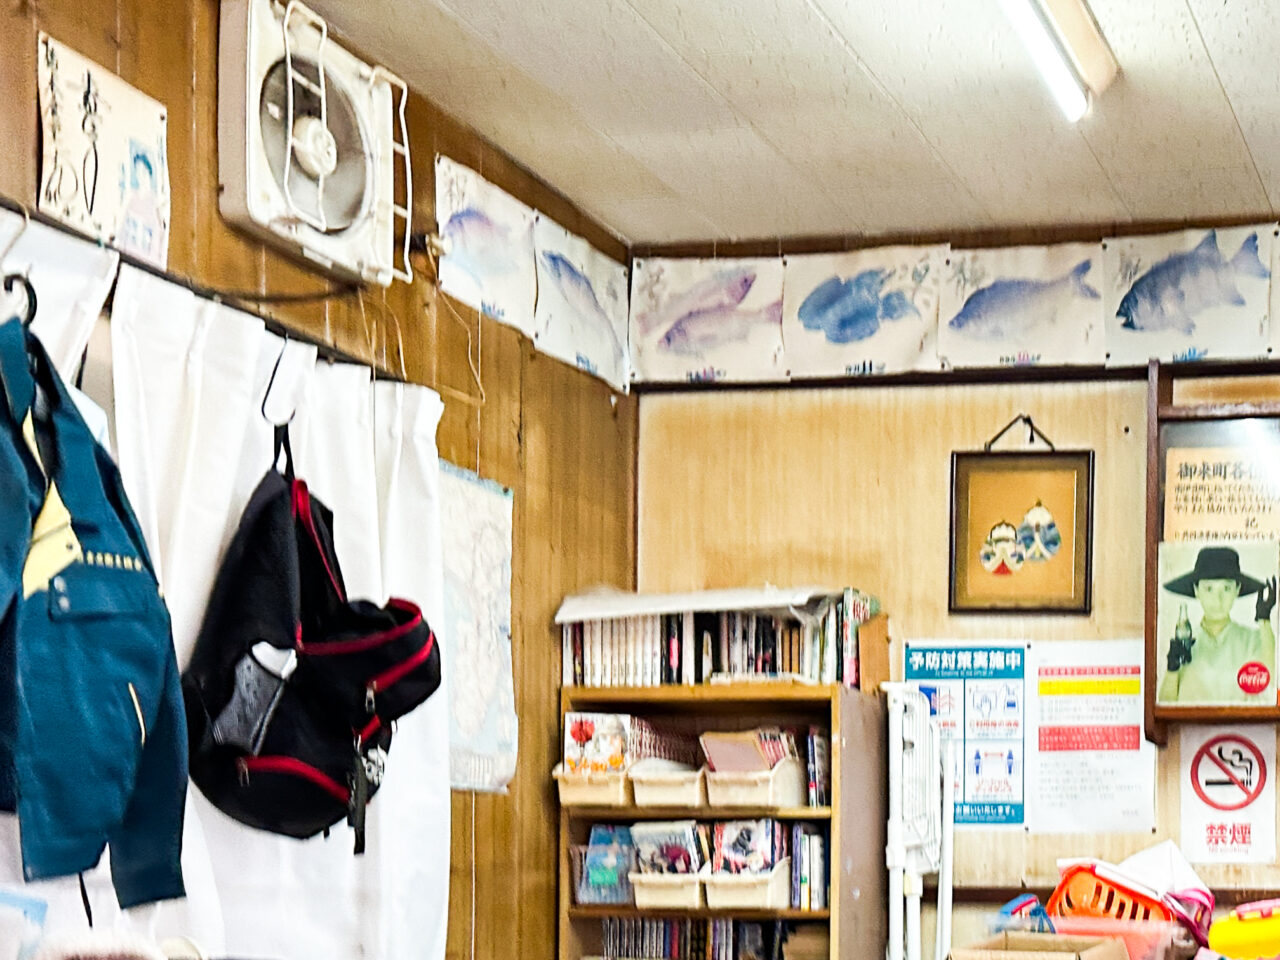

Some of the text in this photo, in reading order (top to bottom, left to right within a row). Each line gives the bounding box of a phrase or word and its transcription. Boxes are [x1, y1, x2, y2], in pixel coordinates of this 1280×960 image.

[909, 650, 1021, 670] 予防対策実施中
[1206, 823, 1251, 845] 禁煙
